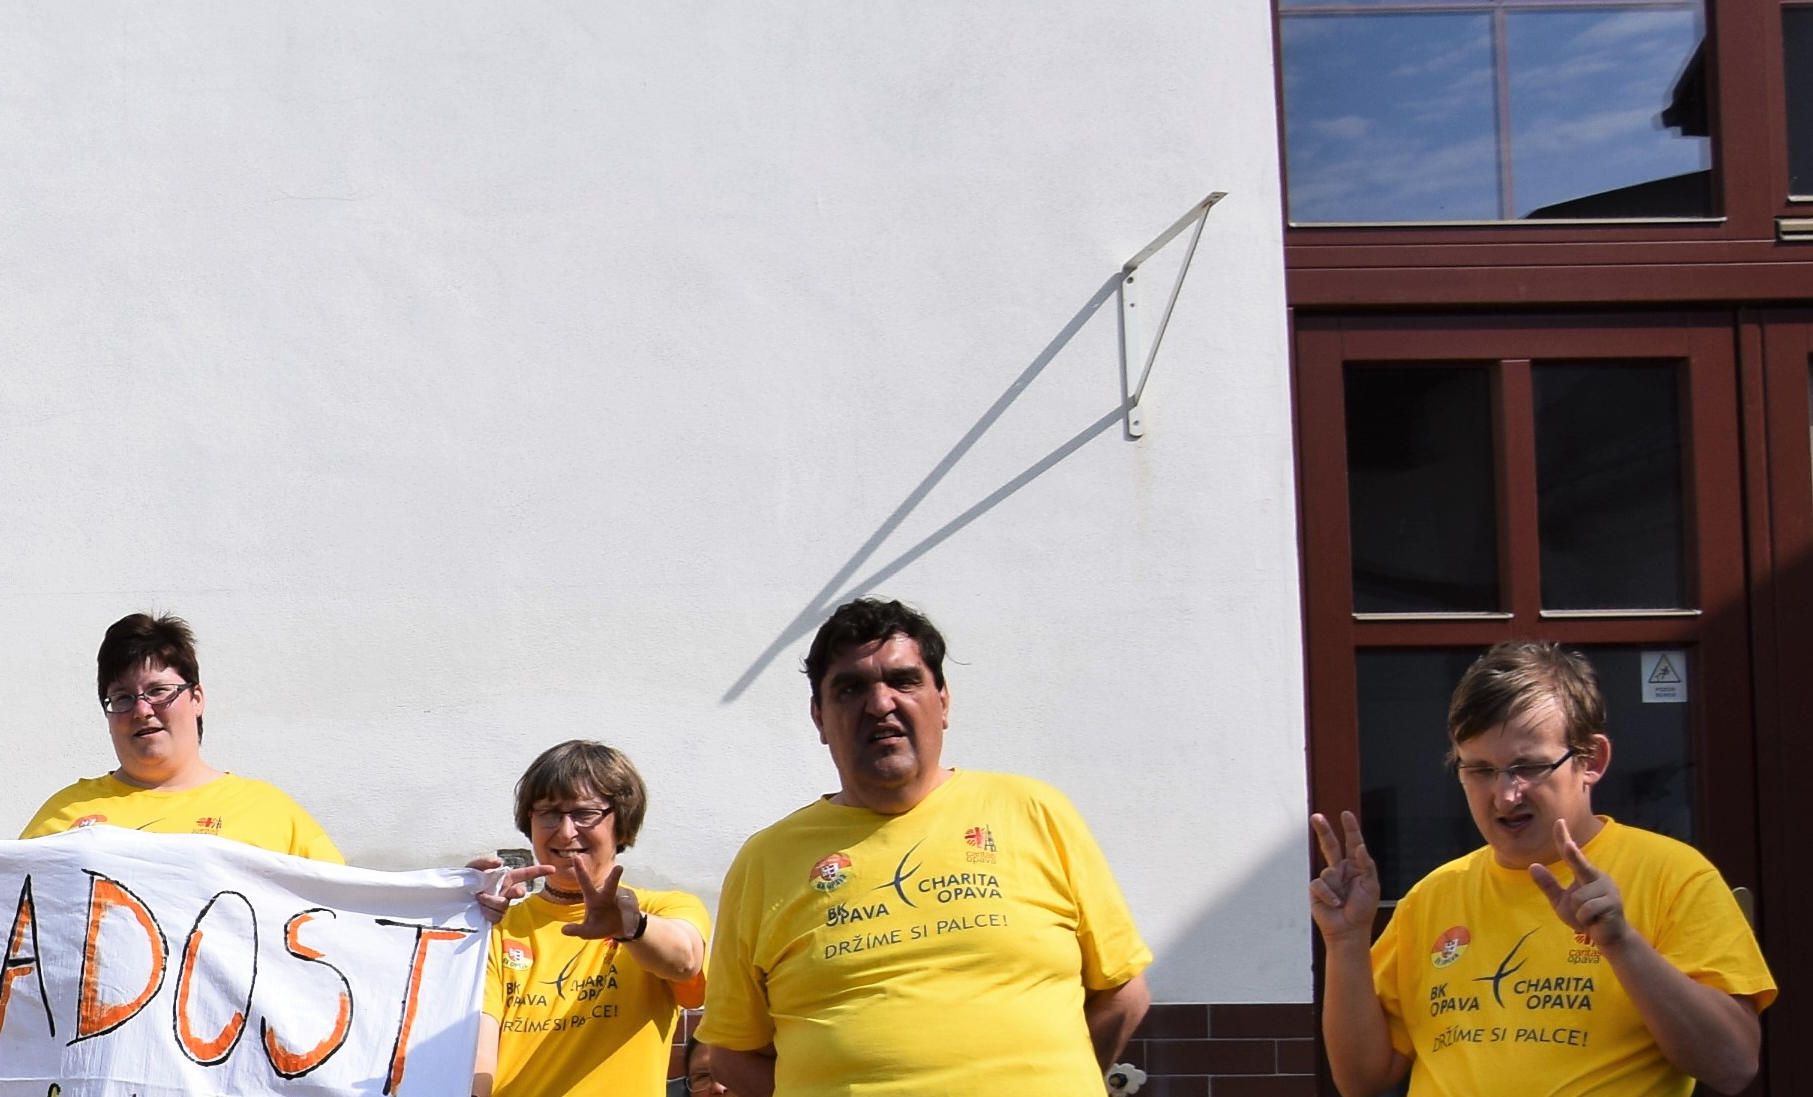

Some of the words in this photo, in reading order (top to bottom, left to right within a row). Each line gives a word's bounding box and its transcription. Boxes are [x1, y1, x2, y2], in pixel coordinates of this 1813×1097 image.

[918, 872, 1000, 893] CHARITA
[937, 886, 1003, 904] OPAVA
[824, 929, 902, 960] DRŽÍME
[910, 924, 928, 941] SI
[937, 913, 1008, 935] PALCE!
[507, 981, 521, 995] BK
[1430, 982, 1448, 1000] BK
[1513, 977, 1595, 995] CHARITA
[1430, 996, 1480, 1017] OPAVA
[1525, 994, 1592, 1011] OPAVA
[502, 1017, 550, 1033] RŽÍME
[553, 1019, 566, 1032] SI
[1432, 1024, 1485, 1053] DRŽÍME
[1490, 1027, 1507, 1042] SI
[1514, 1027, 1589, 1048] PALCE!
